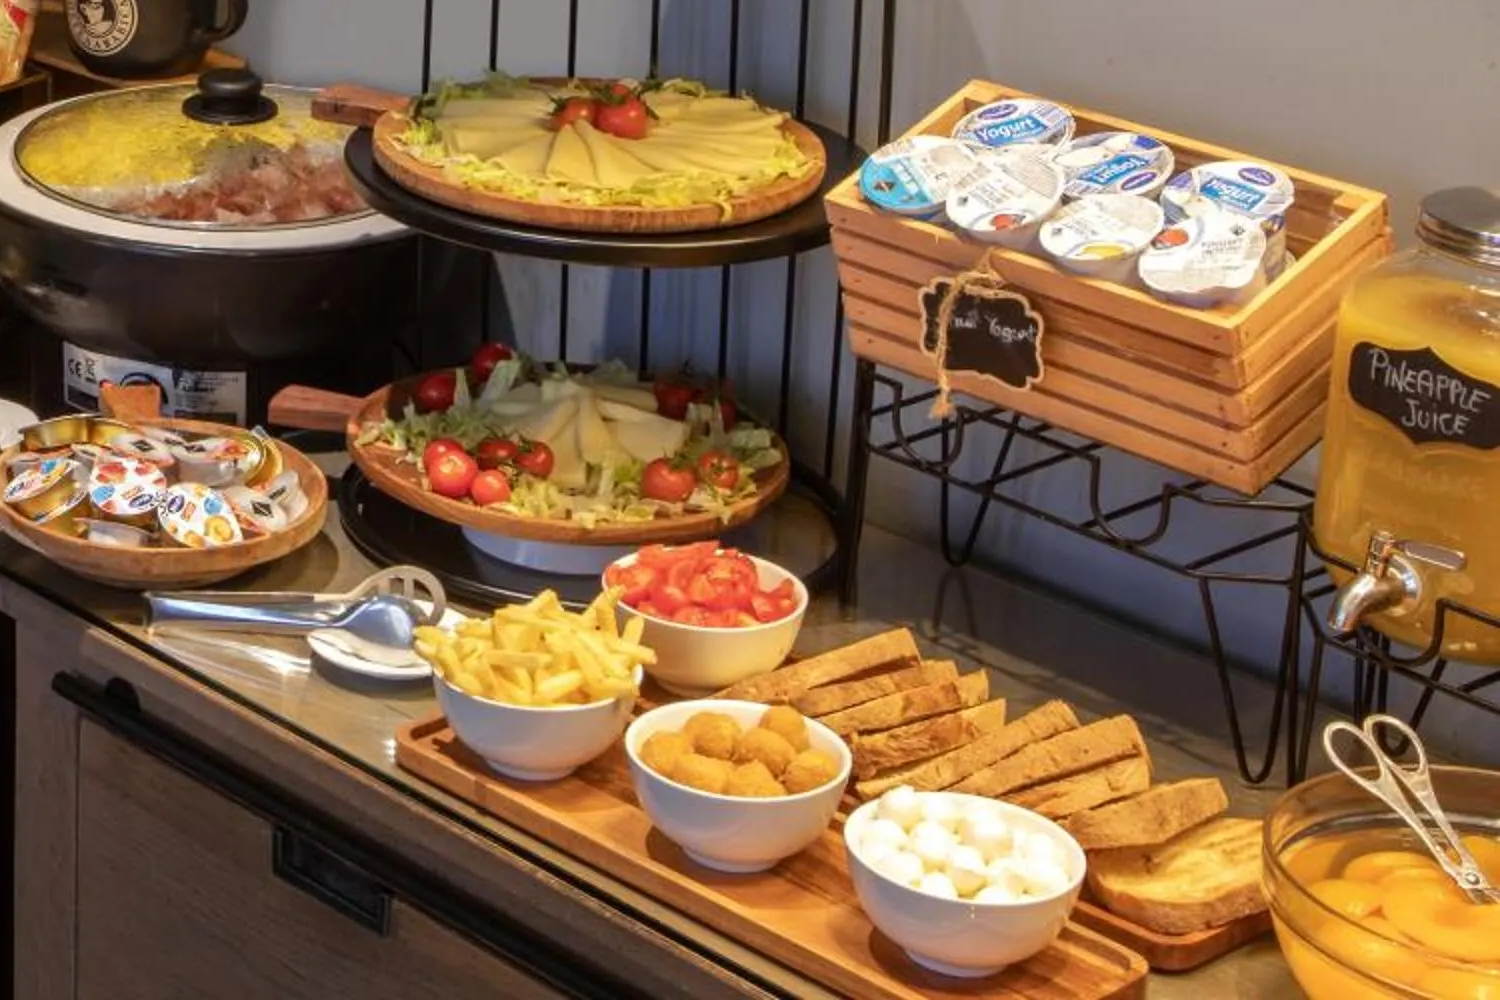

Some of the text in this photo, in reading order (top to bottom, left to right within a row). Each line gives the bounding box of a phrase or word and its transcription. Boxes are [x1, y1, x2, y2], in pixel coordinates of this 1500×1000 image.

[978, 118, 1036, 141] Yogurt
[1369, 349, 1491, 413] PINEAPPLE
[1401, 398, 1470, 436] JUICE
